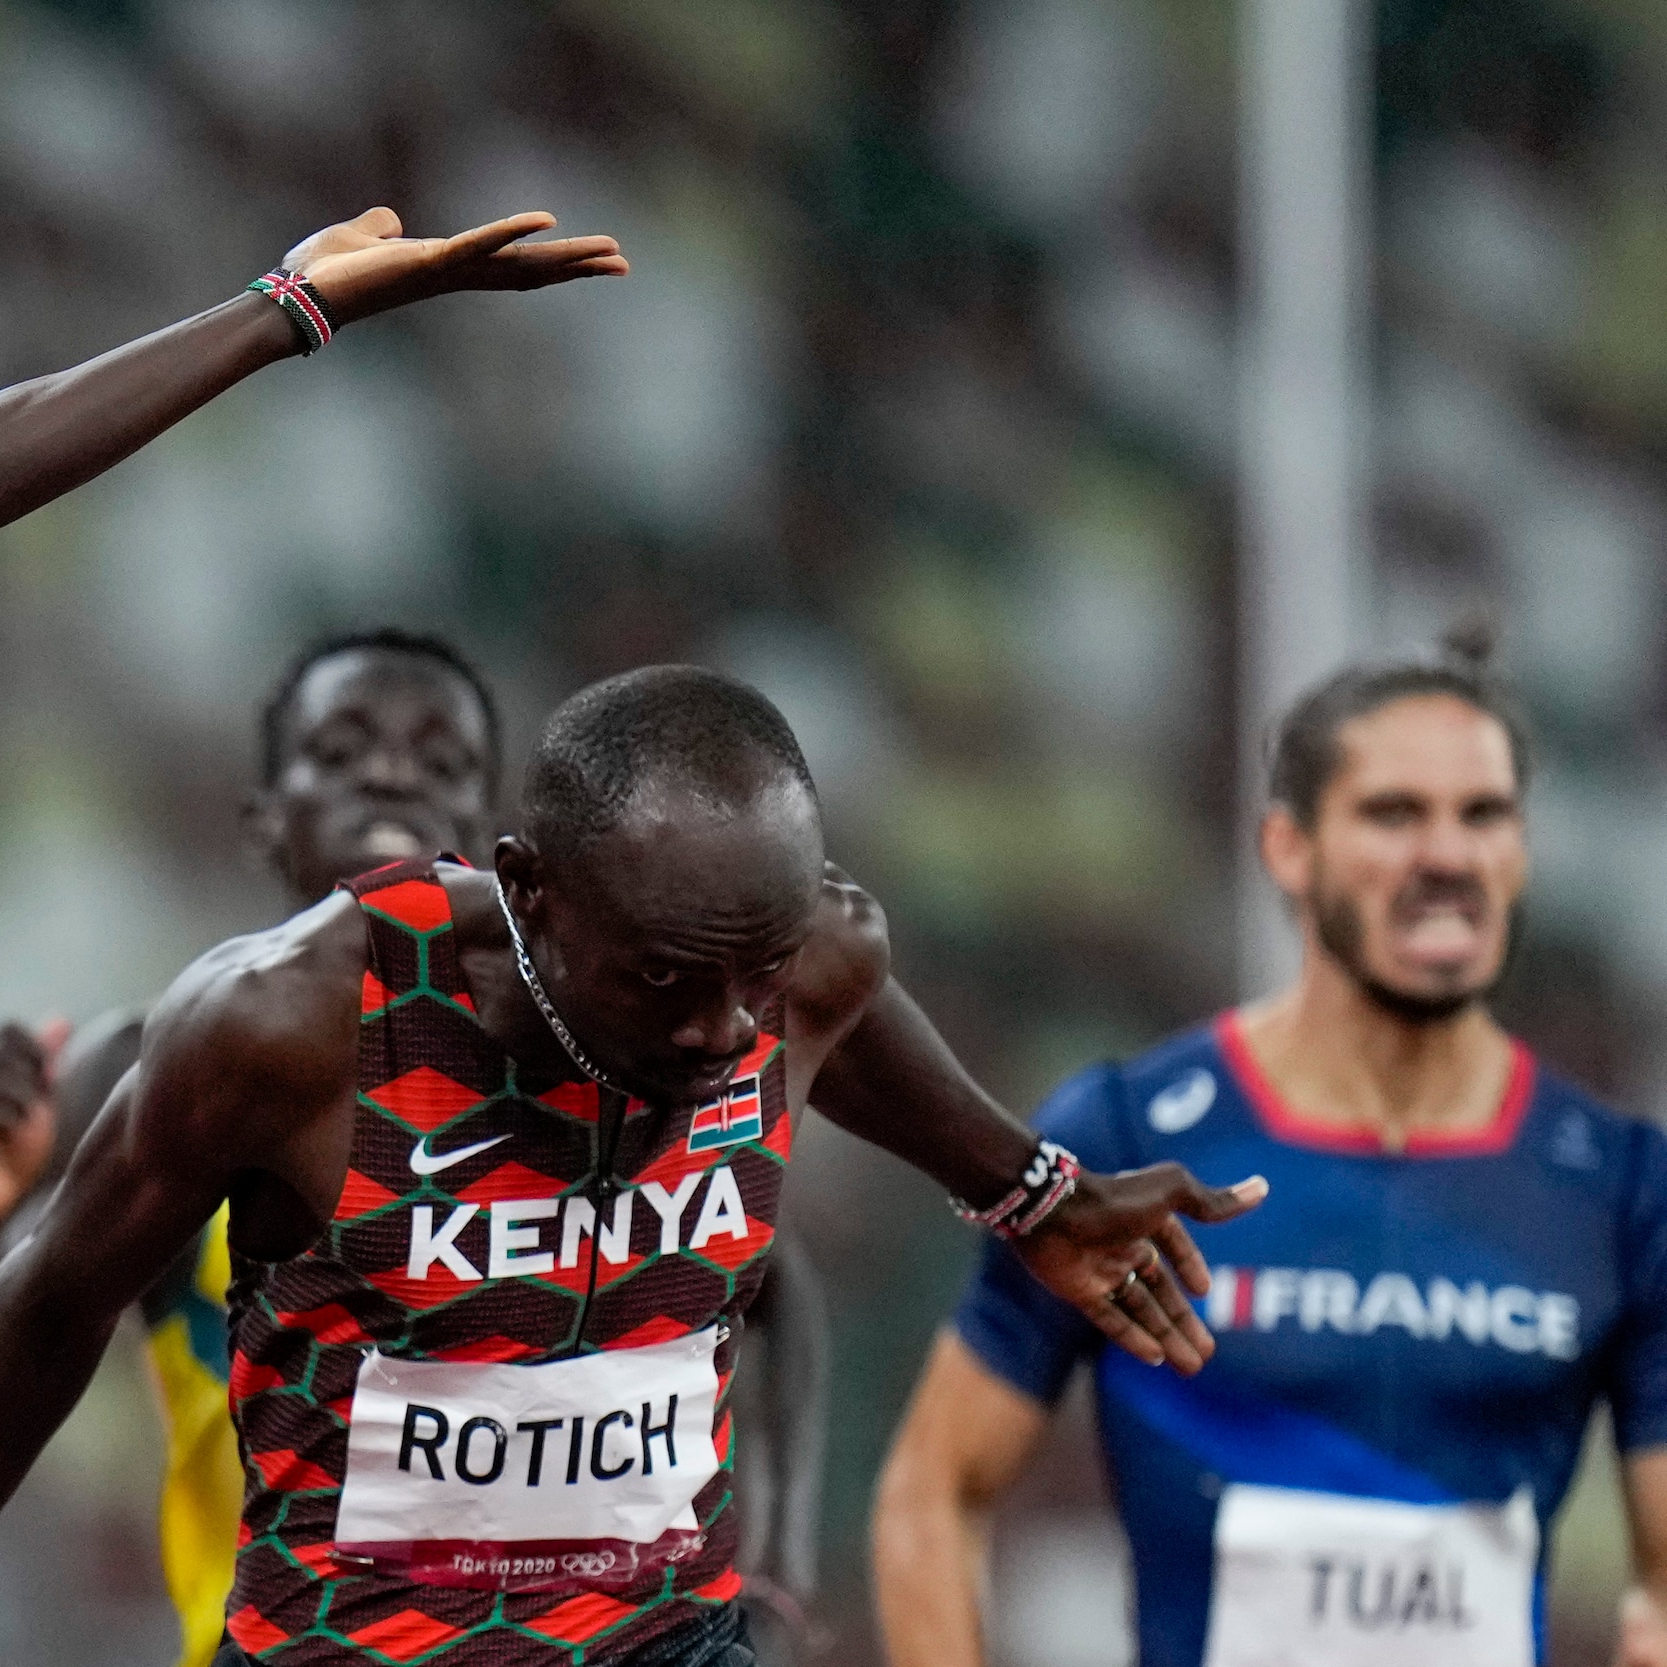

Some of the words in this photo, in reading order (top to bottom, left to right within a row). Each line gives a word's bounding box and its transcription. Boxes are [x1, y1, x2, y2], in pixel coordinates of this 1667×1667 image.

[407, 1166, 749, 1281] KENYA
[1253, 1267, 1579, 1361] FRANCE
[397, 1394, 679, 1487] ROTICH
[453, 1553, 511, 1575] TOKYO
[512, 1557, 556, 1576] 2020
[1307, 1553, 1477, 1632] TUAL
